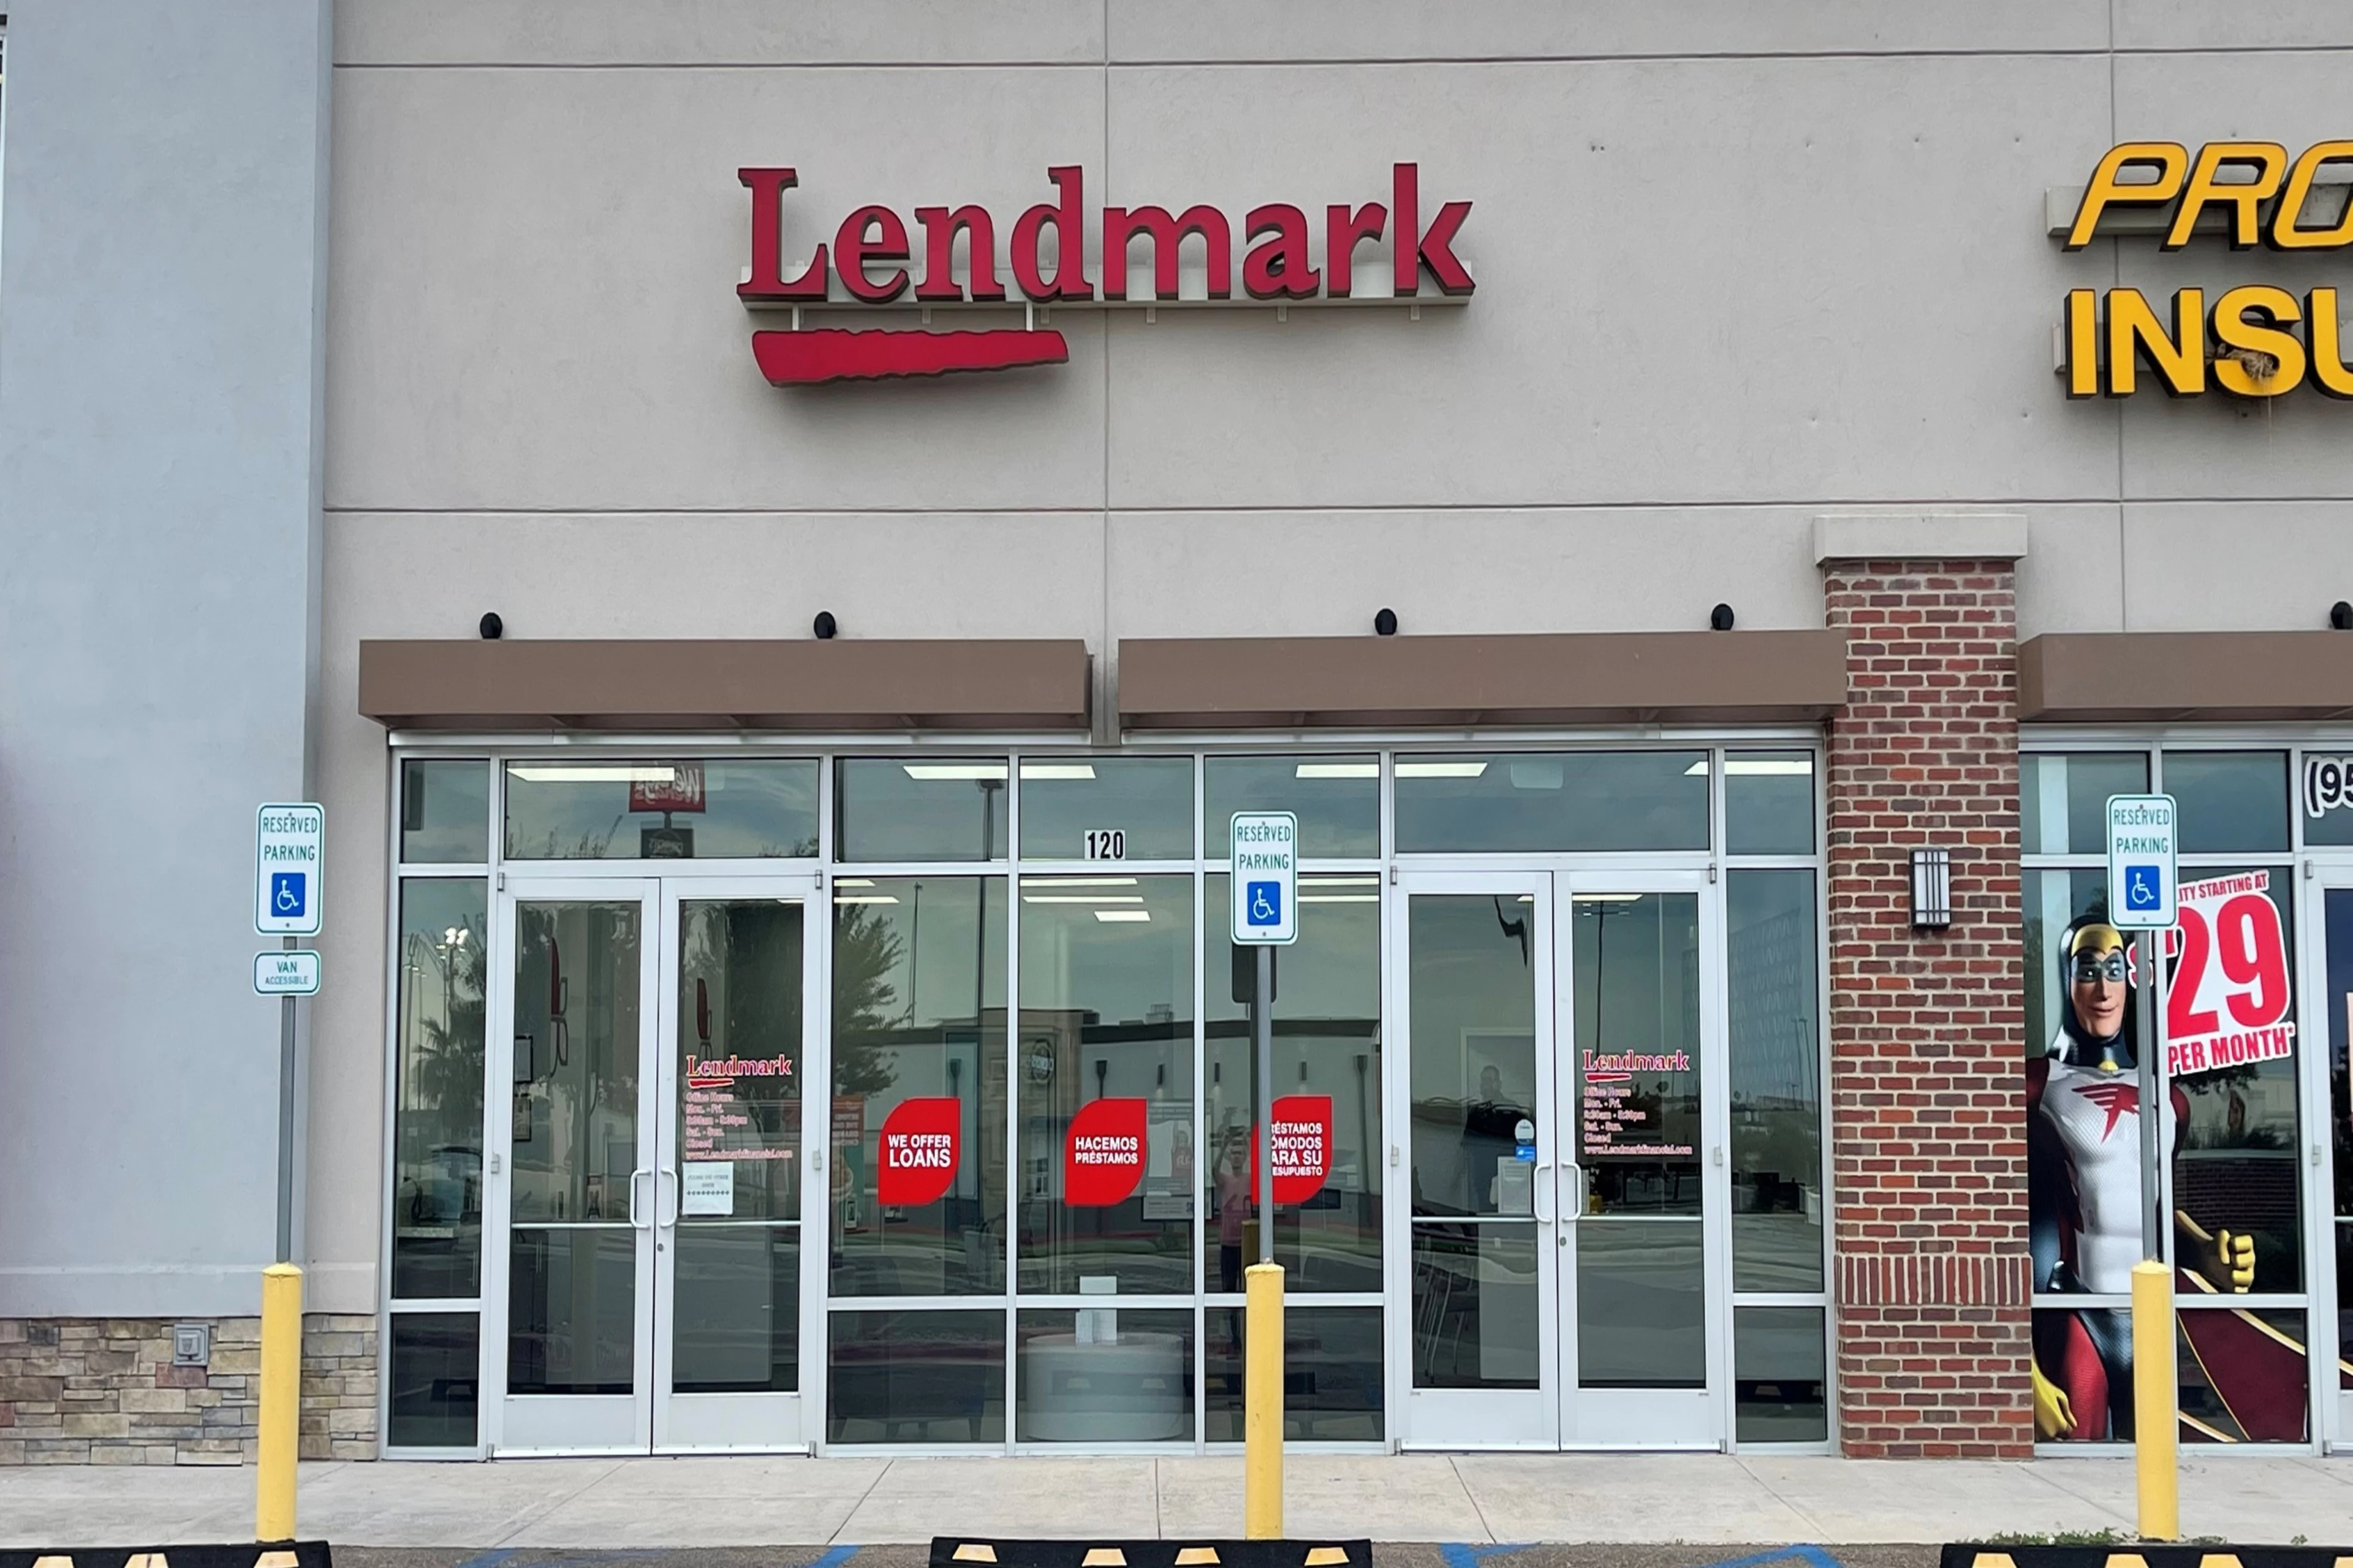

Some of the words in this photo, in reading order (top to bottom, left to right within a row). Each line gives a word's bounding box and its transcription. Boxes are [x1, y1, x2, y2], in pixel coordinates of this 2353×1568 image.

[2063, 140, 2353, 251] PRO
[737, 162, 1476, 303] Lendmark
[262, 817, 317, 833] RESERVED
[2113, 808, 2170, 825] RESERVED
[1237, 825, 1291, 843] RESERVED
[263, 844, 316, 861] PARKING
[1087, 831, 1124, 859] 120
[2116, 837, 2169, 854] PARKING
[1238, 854, 1289, 870] PARKING
[2198, 876, 2253, 899] STARTING
[2254, 873, 2267, 889] AT
[276, 961, 297, 974] VAN
[265, 975, 308, 985] ACCESSIBLE
[686, 1054, 792, 1077] Lendmark
[1582, 1049, 1690, 1071] Lendmark
[2167, 1040, 2206, 1074] PER
[1271, 1120, 1323, 1135] ÉSTAMOS
[888, 1134, 907, 1148] WE
[910, 1134, 952, 1148] OFFER
[1075, 1136, 1139, 1151] HACEMOS
[1271, 1135, 1323, 1150] ÓMODOS
[889, 1148, 952, 1168] LOANS
[1075, 1149, 1139, 1164] PRÉSTAMOS
[1271, 1150, 1299, 1165] ARA
[1302, 1150, 1323, 1165] SU
[1272, 1165, 1323, 1176] ESUPUESTO
